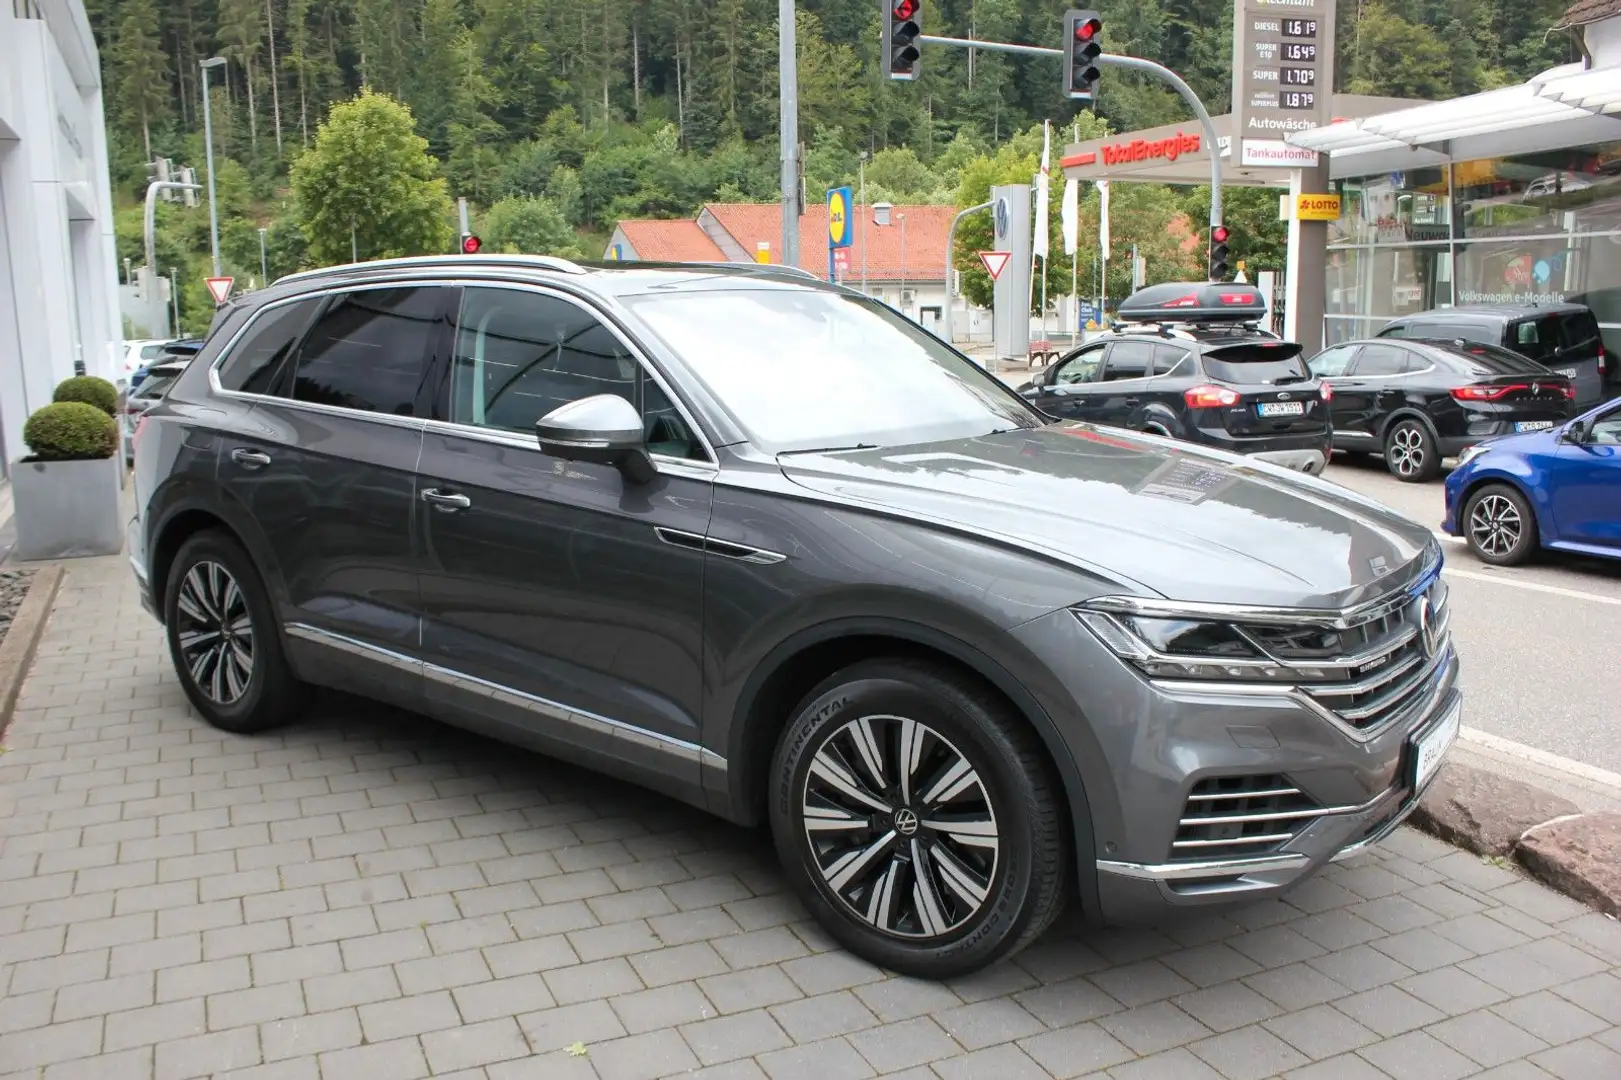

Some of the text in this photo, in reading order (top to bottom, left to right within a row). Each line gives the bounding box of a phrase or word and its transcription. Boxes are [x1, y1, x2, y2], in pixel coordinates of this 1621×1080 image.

[1254, 22, 1279, 31] DIESEL
[1256, 43, 1277, 51] SUPER
[1260, 50, 1272, 58] E10
[1253, 69, 1278, 80] SUPER
[1248, 117, 1317, 131] Autowäsche
[1100, 132, 1200, 166] TotalEnergies
[1246, 147, 1315, 160] Tankautomat
[1311, 200, 1339, 210] LOTTO
[1458, 290, 1565, 304] Volkswagen e-Modelle
[779, 695, 856, 813] CONTINENTAL
